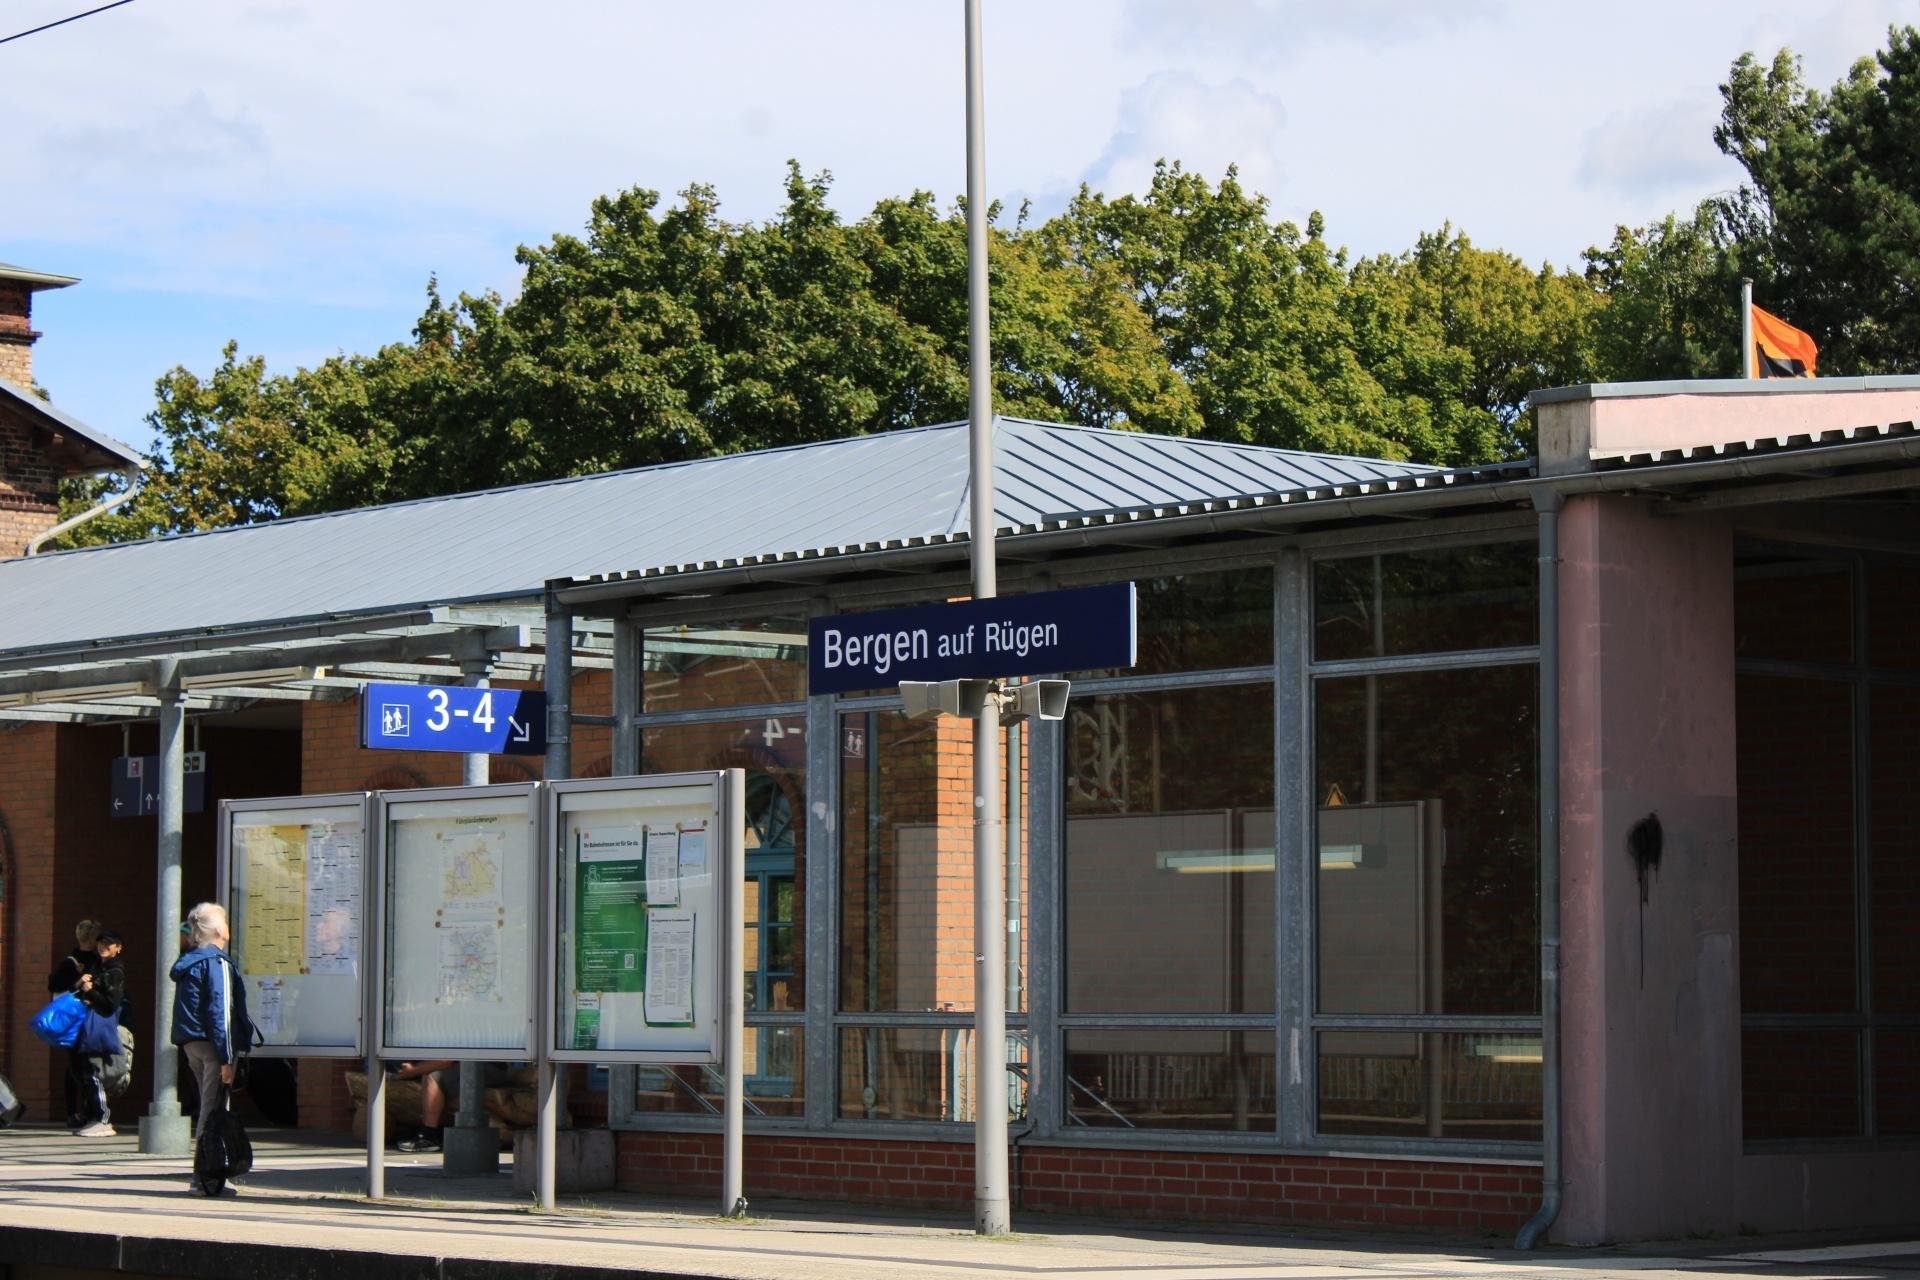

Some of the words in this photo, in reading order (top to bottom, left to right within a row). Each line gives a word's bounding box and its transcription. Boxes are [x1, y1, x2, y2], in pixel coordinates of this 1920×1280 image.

[824, 629, 929, 674] Bergen
[937, 625, 975, 657] auf
[985, 620, 1058, 656] Rügen
[426, 688, 496, 733] 3-4
